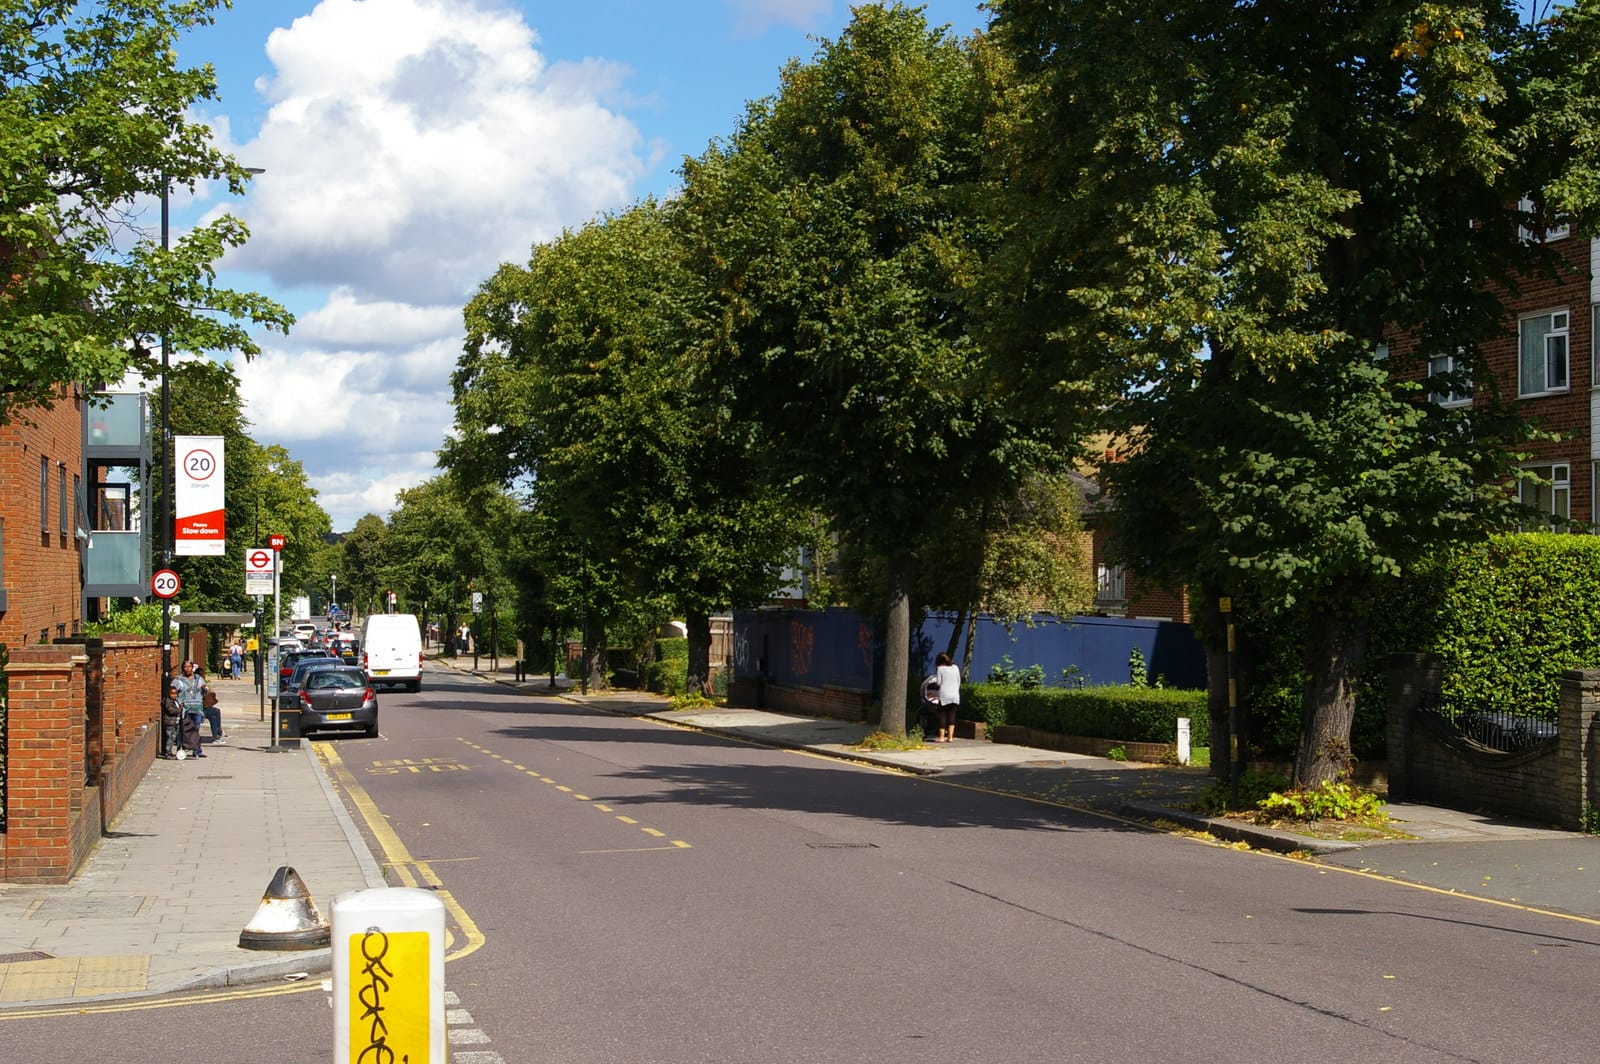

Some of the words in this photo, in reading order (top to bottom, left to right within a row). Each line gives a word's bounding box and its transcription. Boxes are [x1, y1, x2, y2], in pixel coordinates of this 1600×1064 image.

[190, 458, 210, 471] 20
[181, 527, 199, 535] Slow
[199, 527, 219, 535] down
[271, 538, 284, 546] BN
[157, 578, 176, 589] 20
